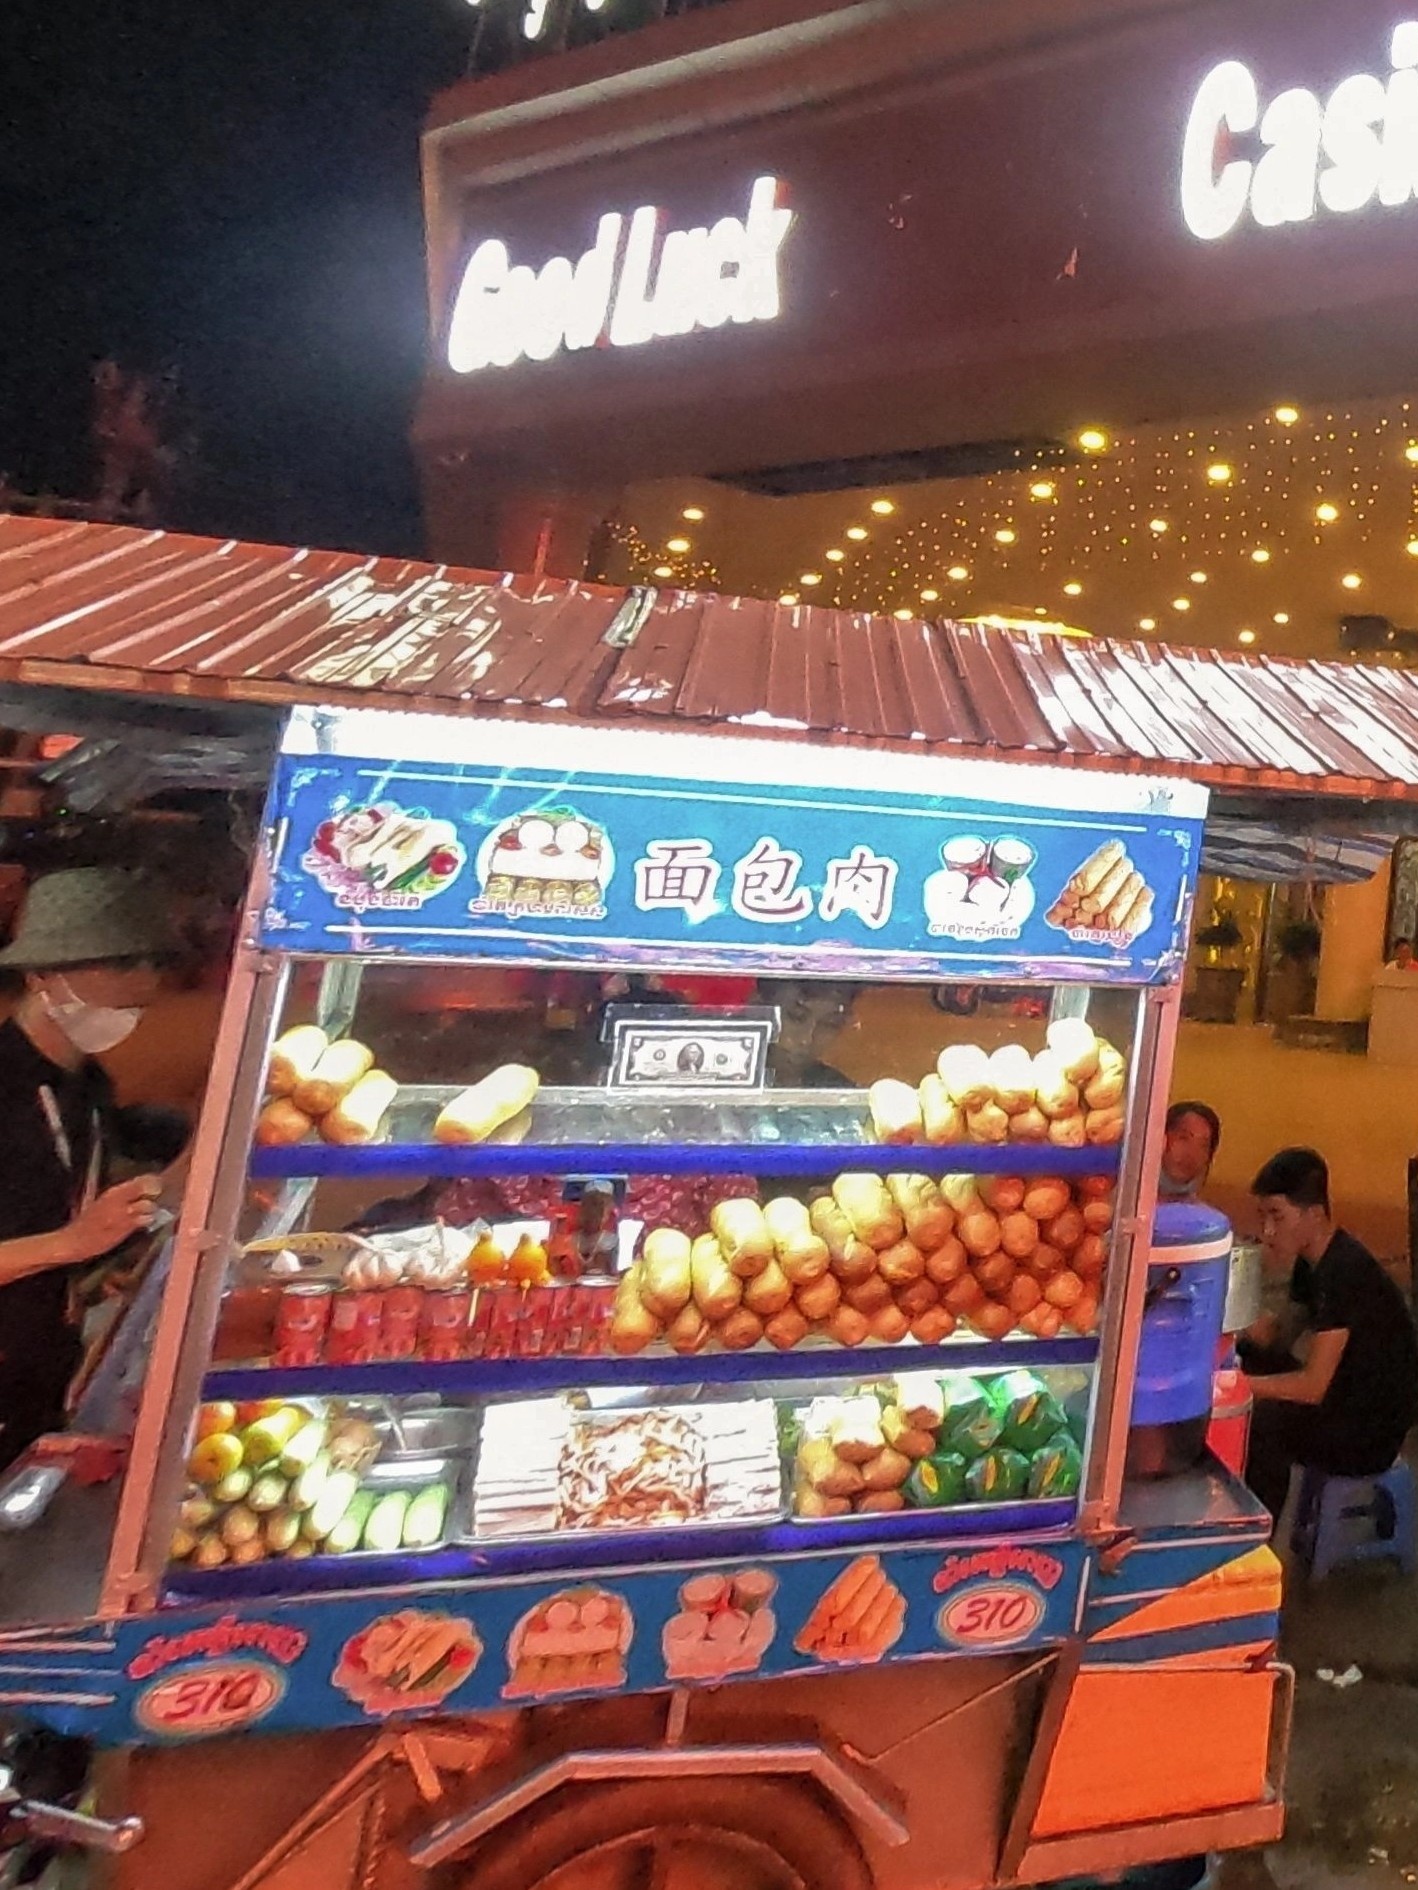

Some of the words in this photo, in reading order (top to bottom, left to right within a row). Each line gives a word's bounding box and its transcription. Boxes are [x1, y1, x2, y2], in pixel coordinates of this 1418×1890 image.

[640, 841, 895, 924] 面包肉
[955, 1595, 1028, 1635] 310
[163, 1670, 262, 1722] 310
